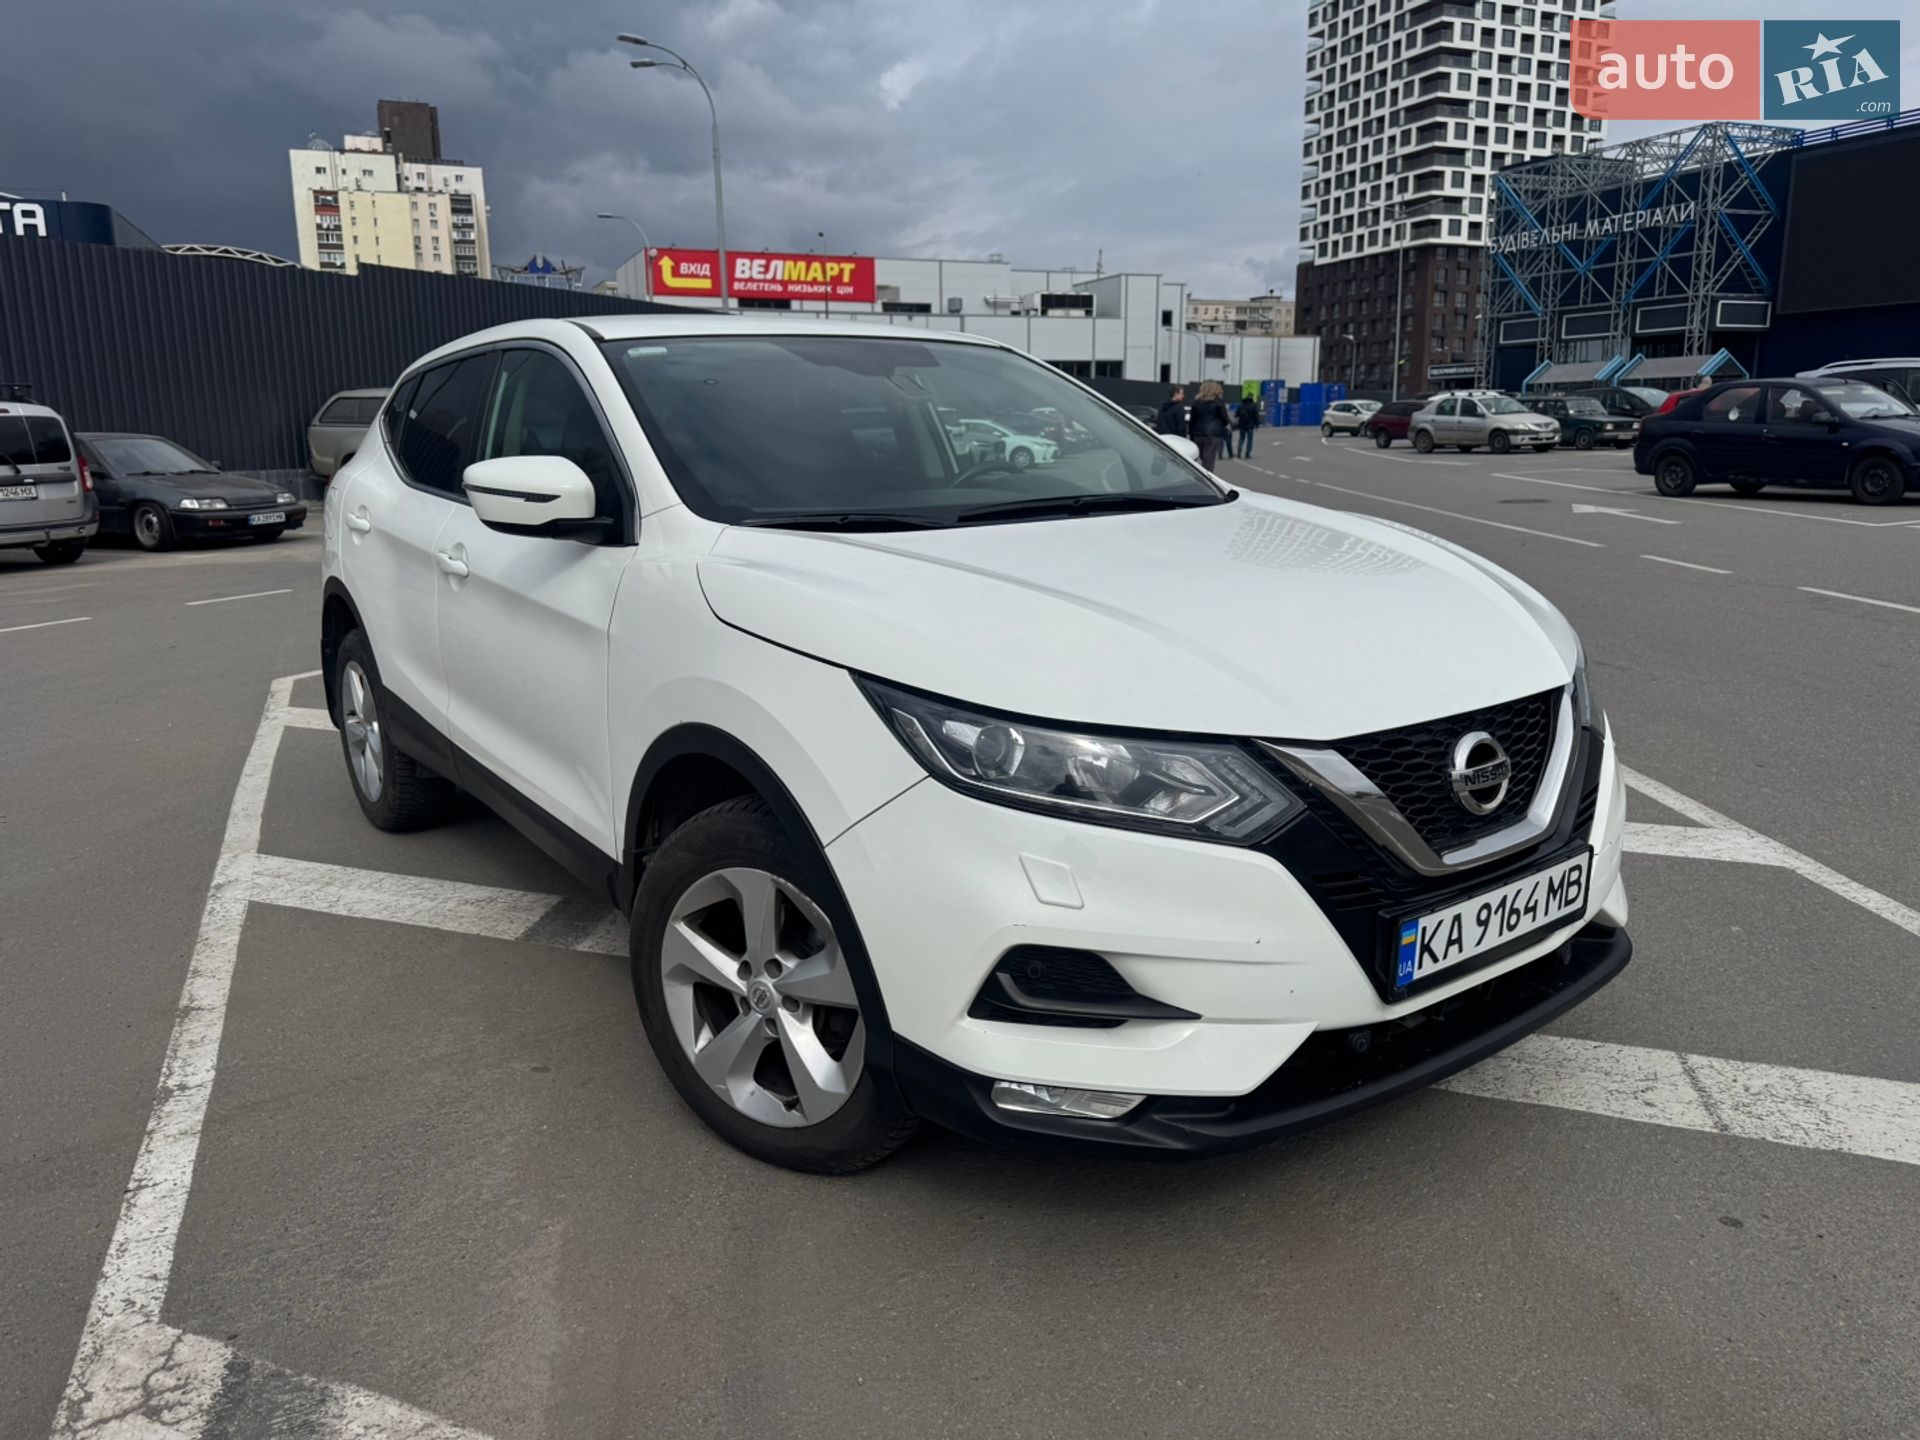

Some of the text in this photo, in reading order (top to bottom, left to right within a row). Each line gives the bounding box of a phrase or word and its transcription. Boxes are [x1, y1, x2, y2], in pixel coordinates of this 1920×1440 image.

[1488, 201, 1695, 255] БУДІВЕЛЬНІ МАТЕРІАЛИ
[680, 262, 711, 277] ВХІД
[734, 258, 856, 283] ВЕЛМАРТ
[733, 281, 783, 292] ВЕЛЕТЕНЬ
[836, 285, 854, 295] ЦІН
[1417, 863, 1583, 970] KA 9164 MB
[1398, 963, 1413, 977] UA
